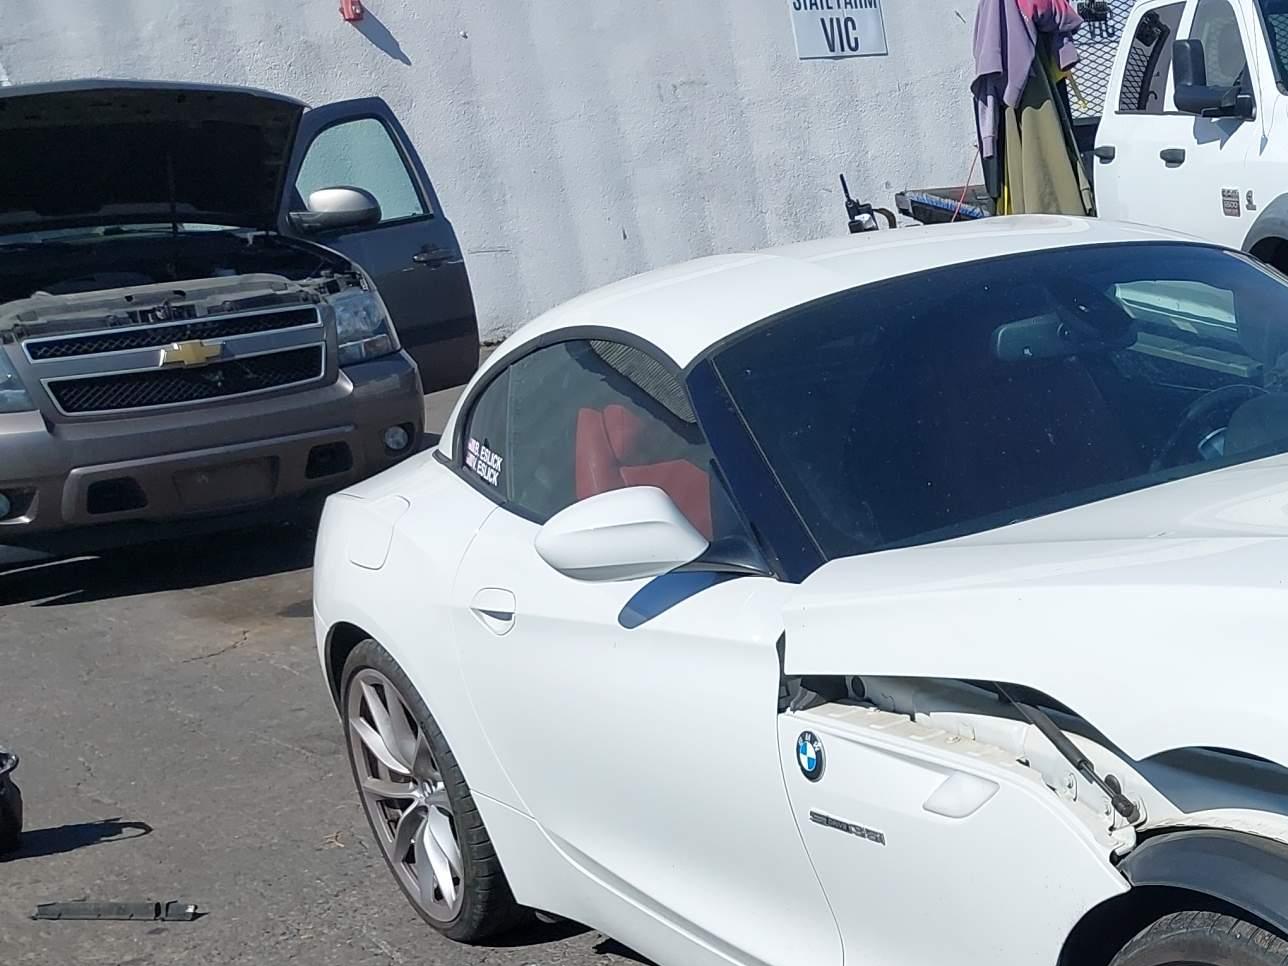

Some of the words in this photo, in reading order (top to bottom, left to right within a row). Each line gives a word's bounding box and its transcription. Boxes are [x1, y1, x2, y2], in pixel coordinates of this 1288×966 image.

[820, 16, 859, 52] VIC
[480, 446, 503, 472] ESLICK
[477, 460, 499, 486] ESLICK
